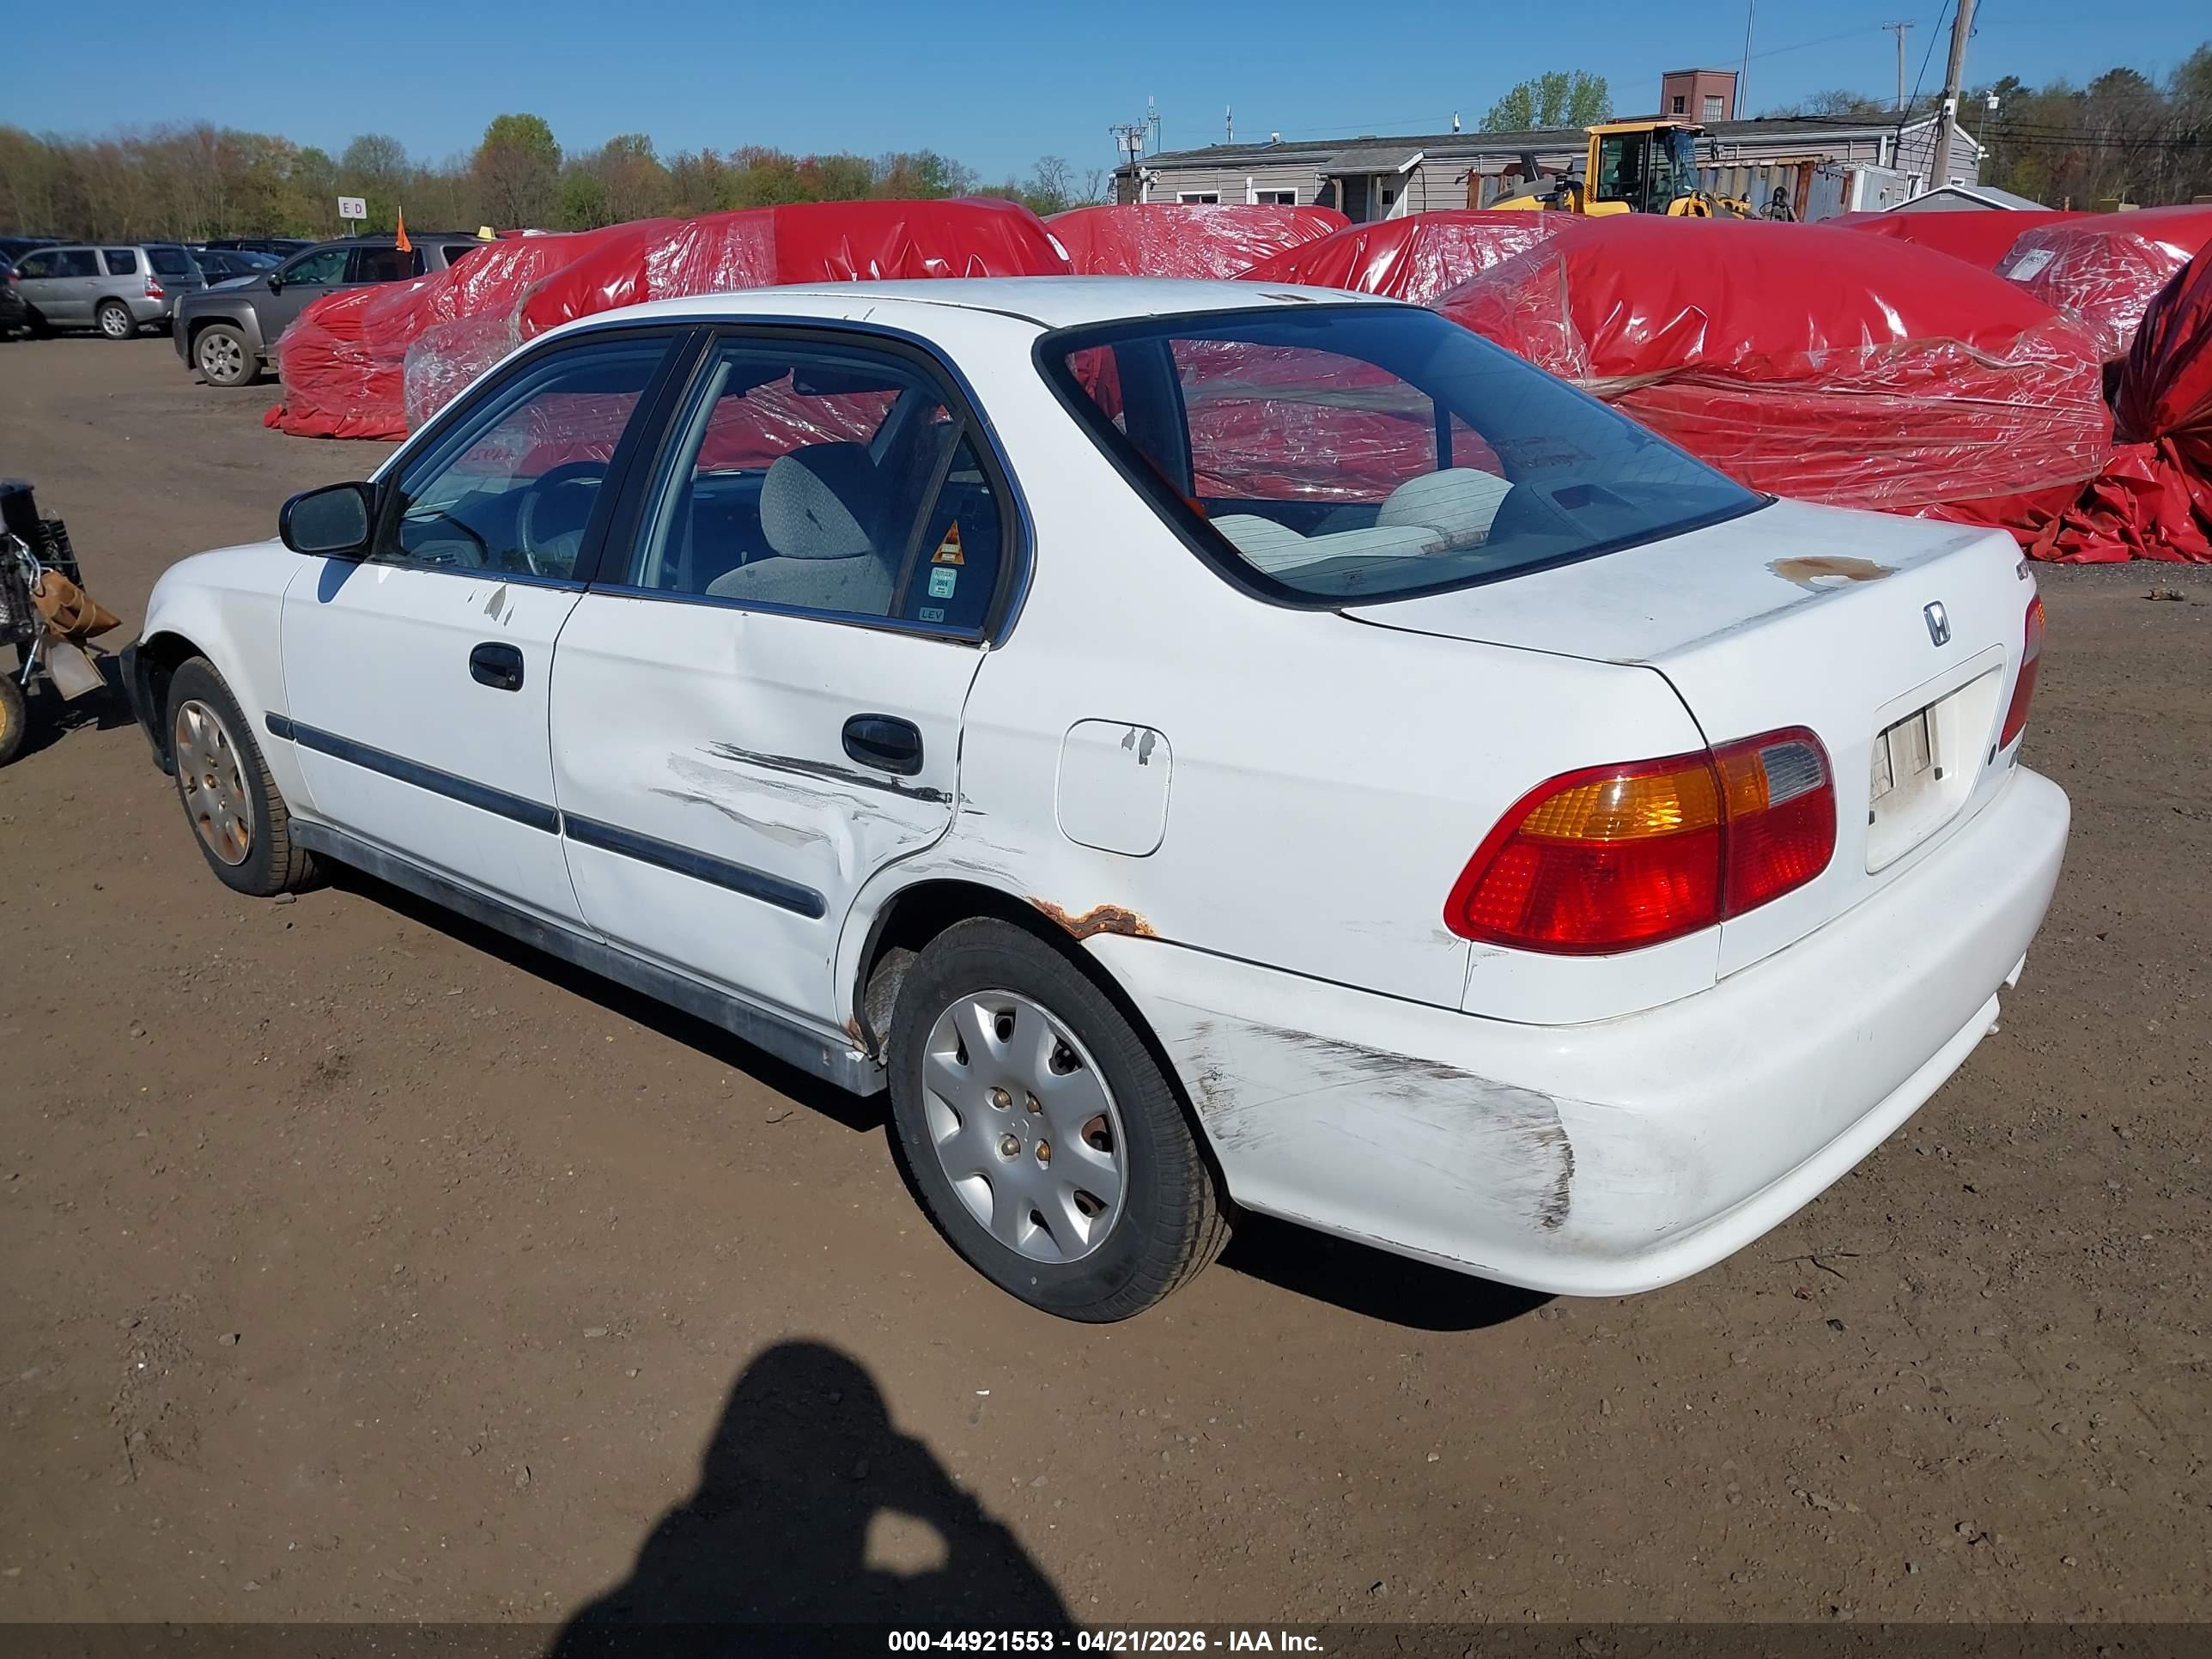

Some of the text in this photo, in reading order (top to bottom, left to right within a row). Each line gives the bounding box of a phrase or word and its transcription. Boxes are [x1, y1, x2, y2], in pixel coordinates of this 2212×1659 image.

[343, 203, 362, 214] E D
[921, 611, 943, 619] LEV
